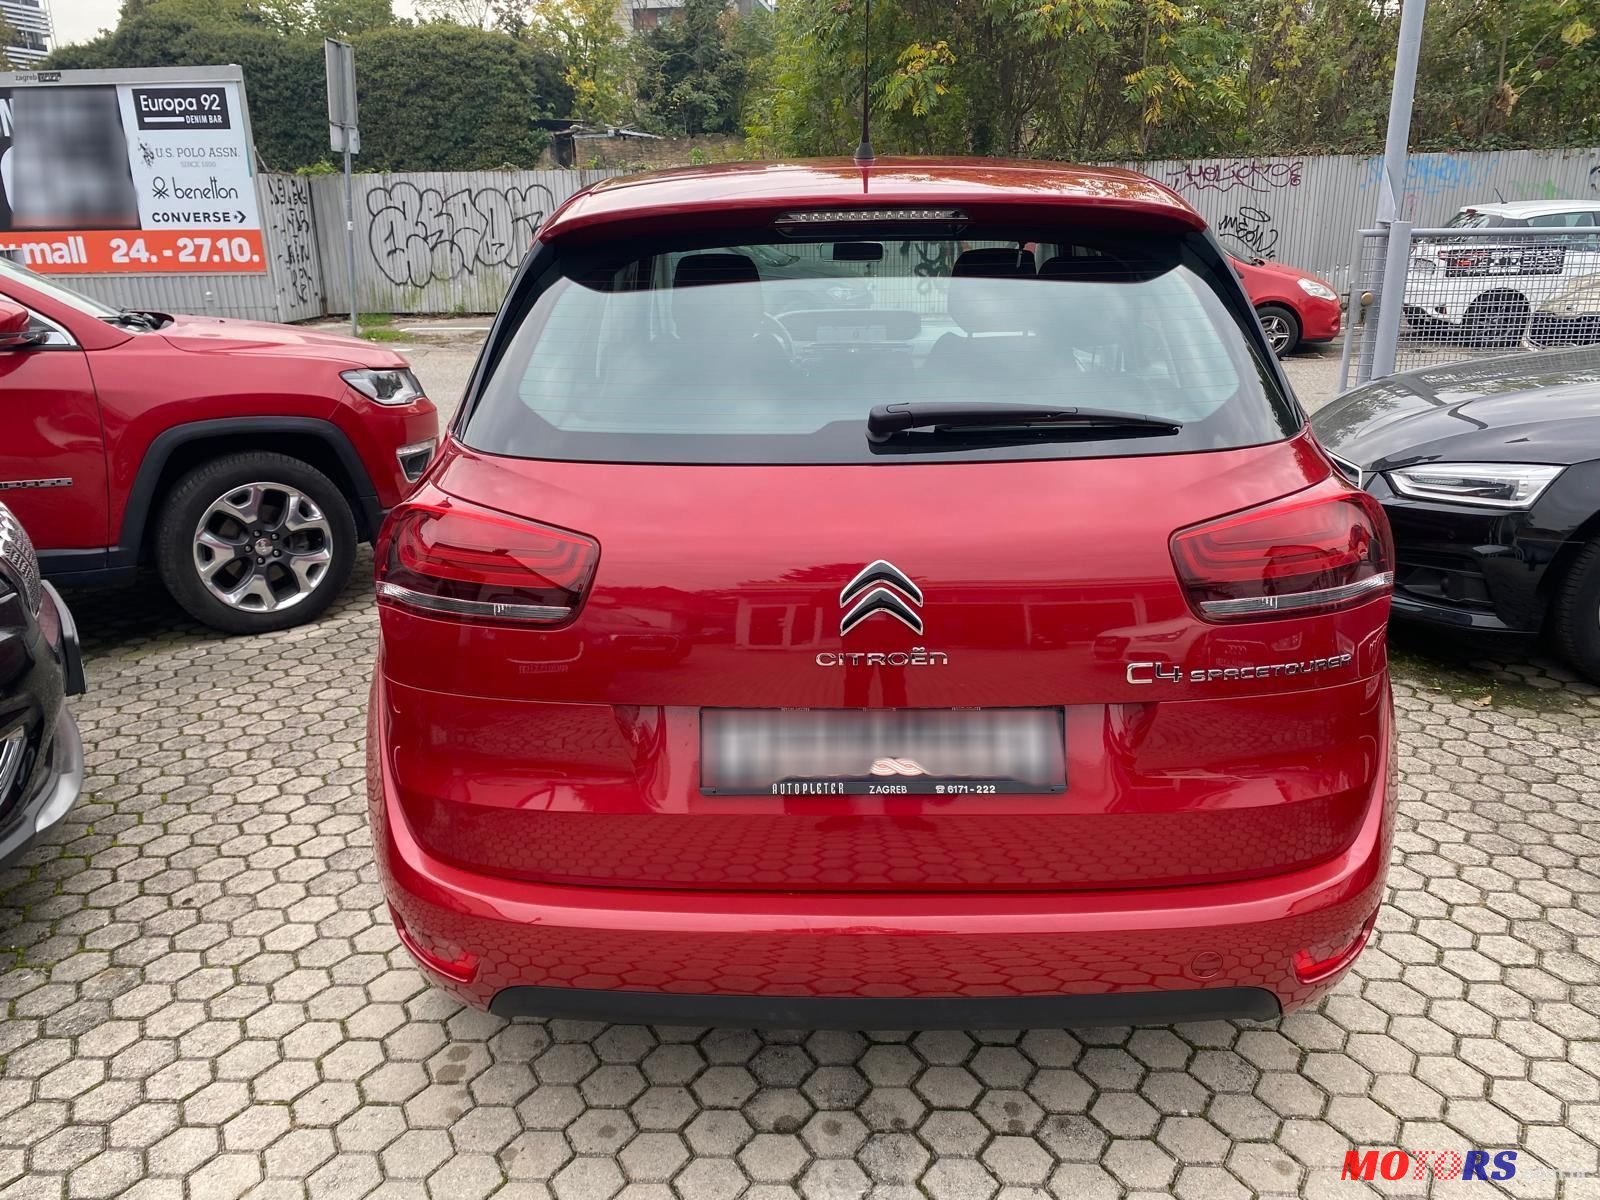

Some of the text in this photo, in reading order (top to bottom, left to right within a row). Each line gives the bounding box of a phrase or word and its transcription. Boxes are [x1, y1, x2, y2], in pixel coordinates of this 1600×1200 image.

[140, 94, 221, 115] Europa 92
[185, 115, 223, 124] DENIM BAR
[177, 148, 206, 158] POLO
[172, 176, 238, 199] benetton
[152, 212, 231, 223] CONVERSE
[22, 236, 88, 264] mall
[1126, 653, 1352, 685] C4 SPACETOURER
[772, 782, 844, 795] AUTOPLETER
[869, 785, 908, 794] ZAGREB
